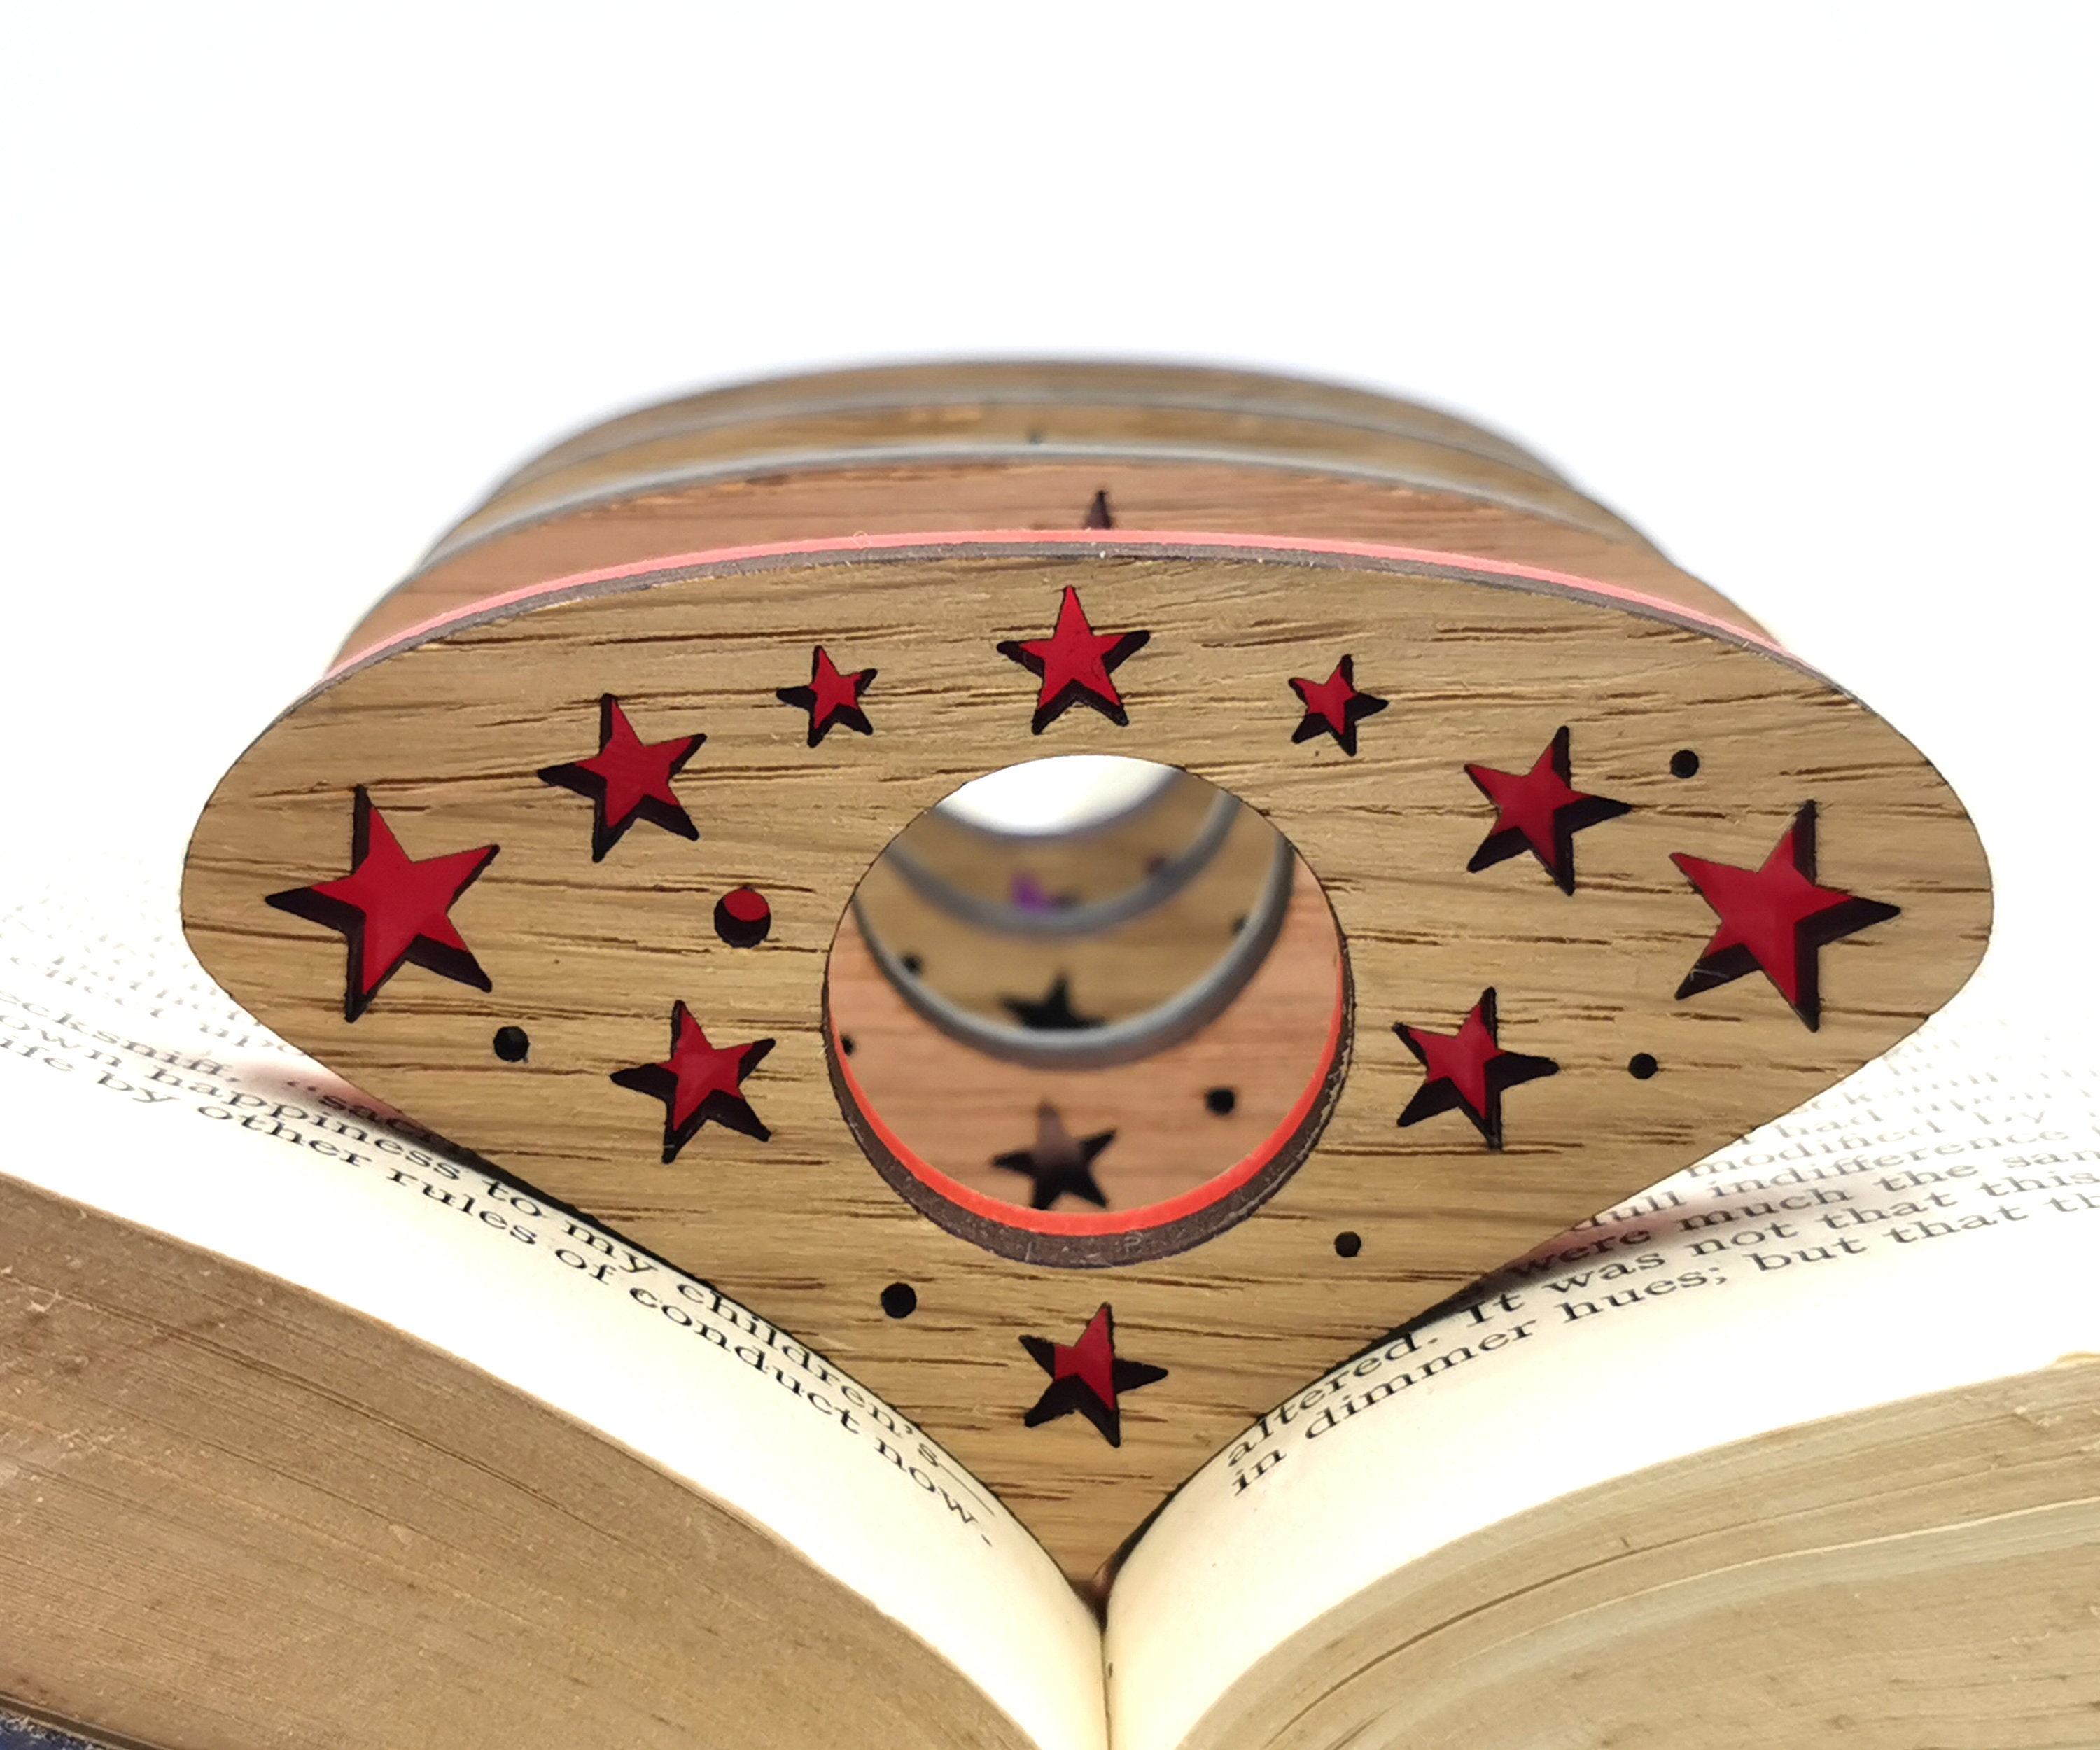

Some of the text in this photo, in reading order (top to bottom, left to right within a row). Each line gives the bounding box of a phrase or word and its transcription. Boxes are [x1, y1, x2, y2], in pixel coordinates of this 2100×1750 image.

[0, 1015, 122, 1070] own
[143, 1065, 462, 1181] happiness
[482, 1180, 547, 1219] to
[561, 1219, 659, 1273] my
[97, 1070, 181, 1103] by
[197, 1106, 373, 1168] other
[385, 1167, 539, 1245] rules
[555, 1248, 617, 1286] of
[629, 1287, 860, 1434] conduct
[1674, 1186, 1855, 1233] much
[1872, 1164, 1979, 1193] the
[1708, 1130, 2070, 1199] indifference
[1227, 1170, 2100, 1468] altered. It was not that this
[1233, 1448, 1287, 1497] in
[1303, 1318, 1538, 1441] dimmer
[1554, 1266, 1729, 1324] hues;
[1742, 1237, 1868, 1271] but
[1882, 1205, 2029, 1244] that
